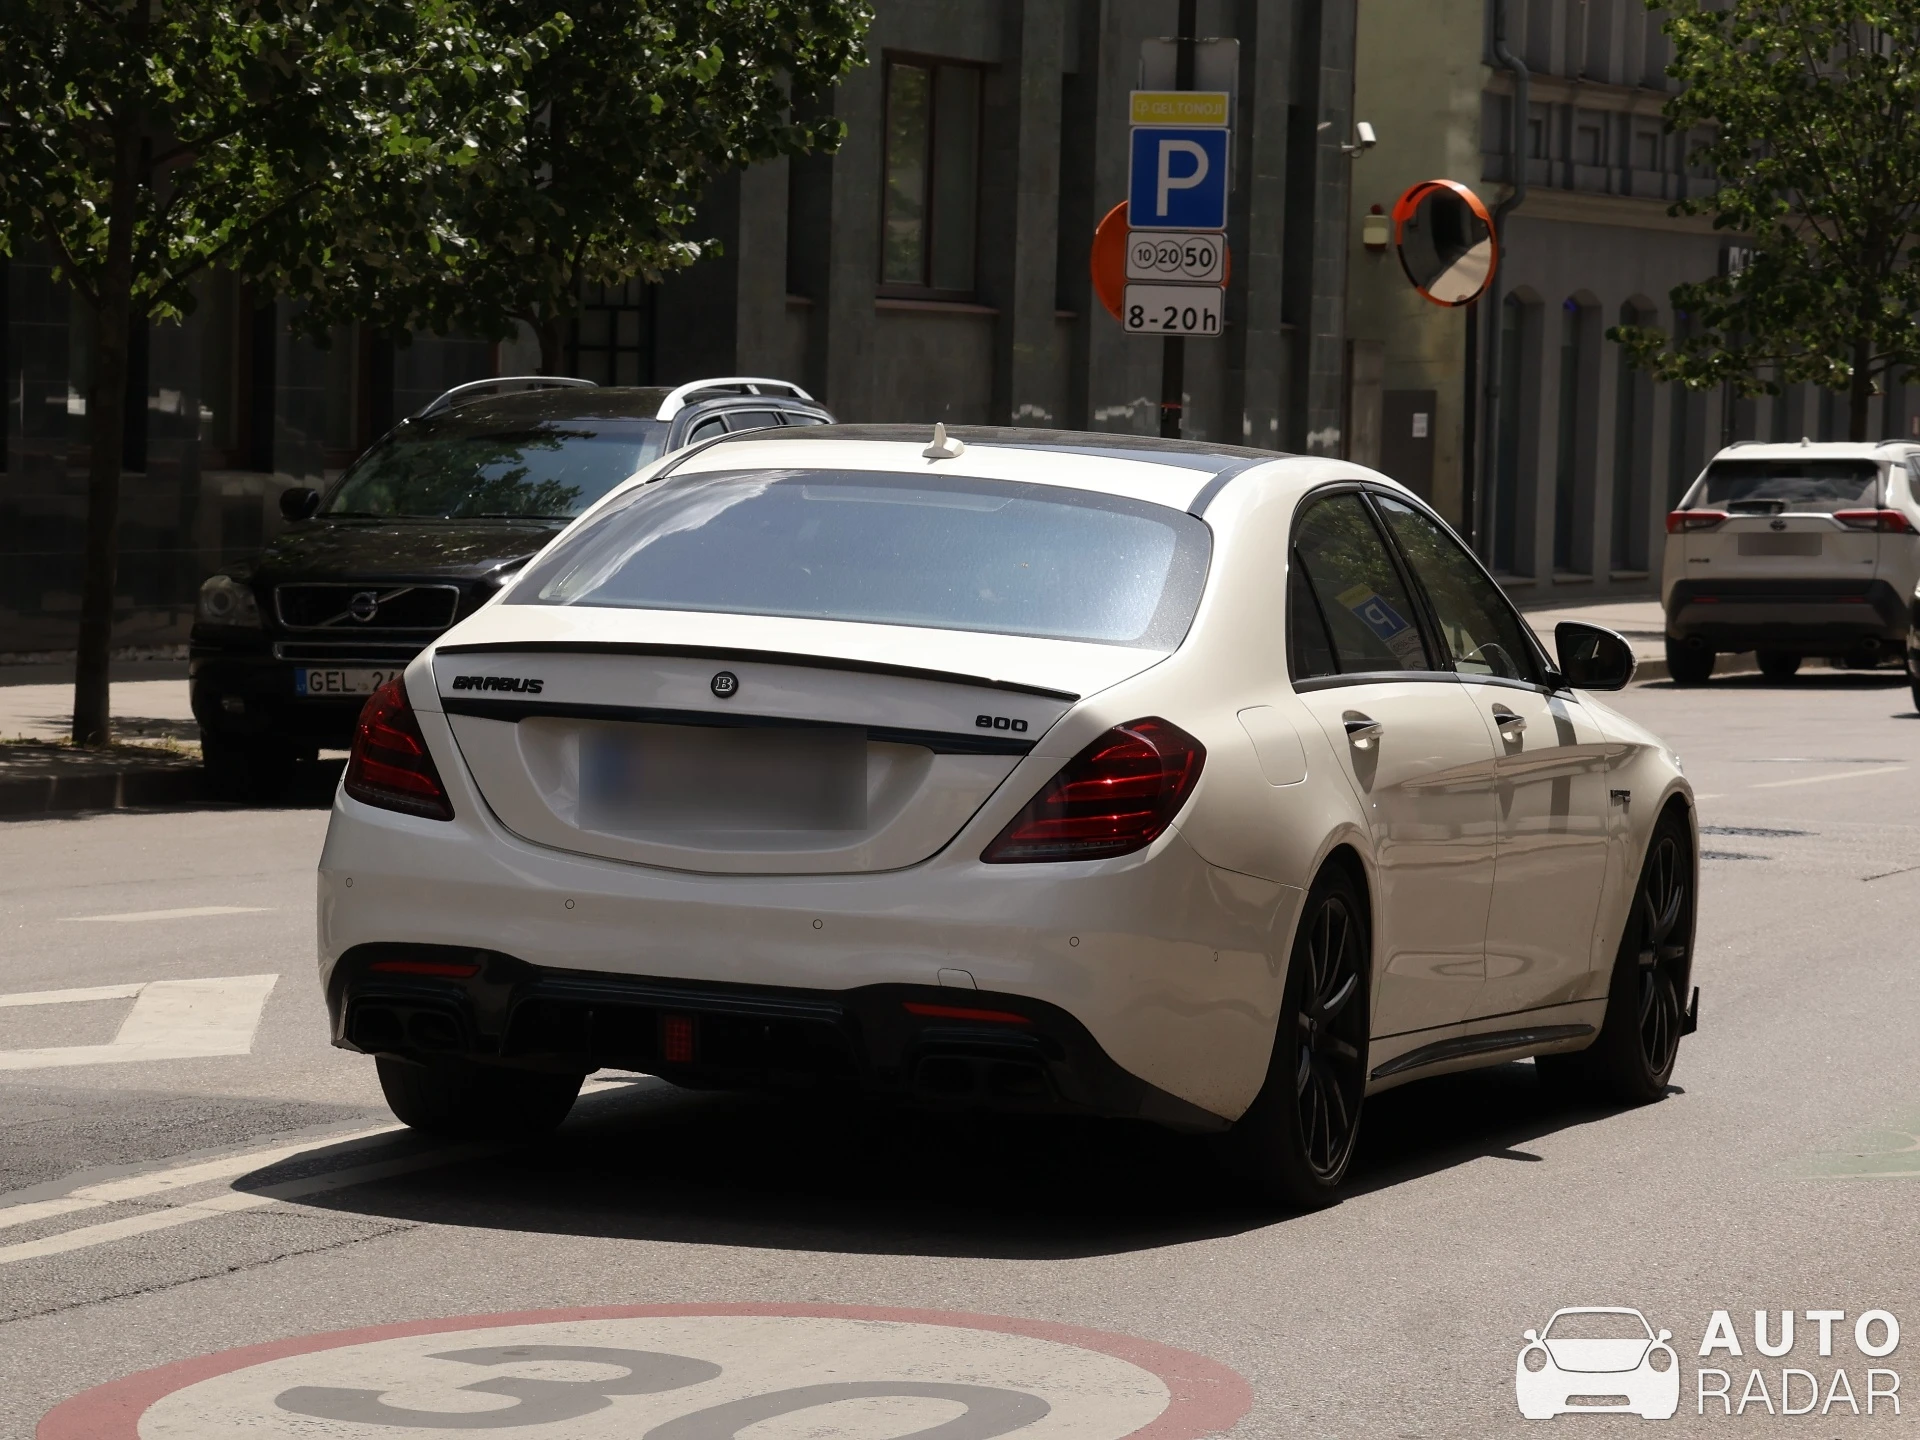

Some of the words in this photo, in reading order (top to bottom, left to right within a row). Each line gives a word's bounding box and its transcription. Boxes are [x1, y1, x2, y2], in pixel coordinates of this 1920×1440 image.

[1152, 102, 1222, 115] GELTONOJI
[1156, 139, 1209, 216] P
[1137, 248, 1151, 262] 10
[1158, 248, 1178, 264] 20
[1184, 247, 1212, 267] 50
[310, 671, 356, 692] GEL
[452, 675, 544, 694] BRABUS
[715, 676, 733, 692] B
[975, 714, 1028, 733] 800
